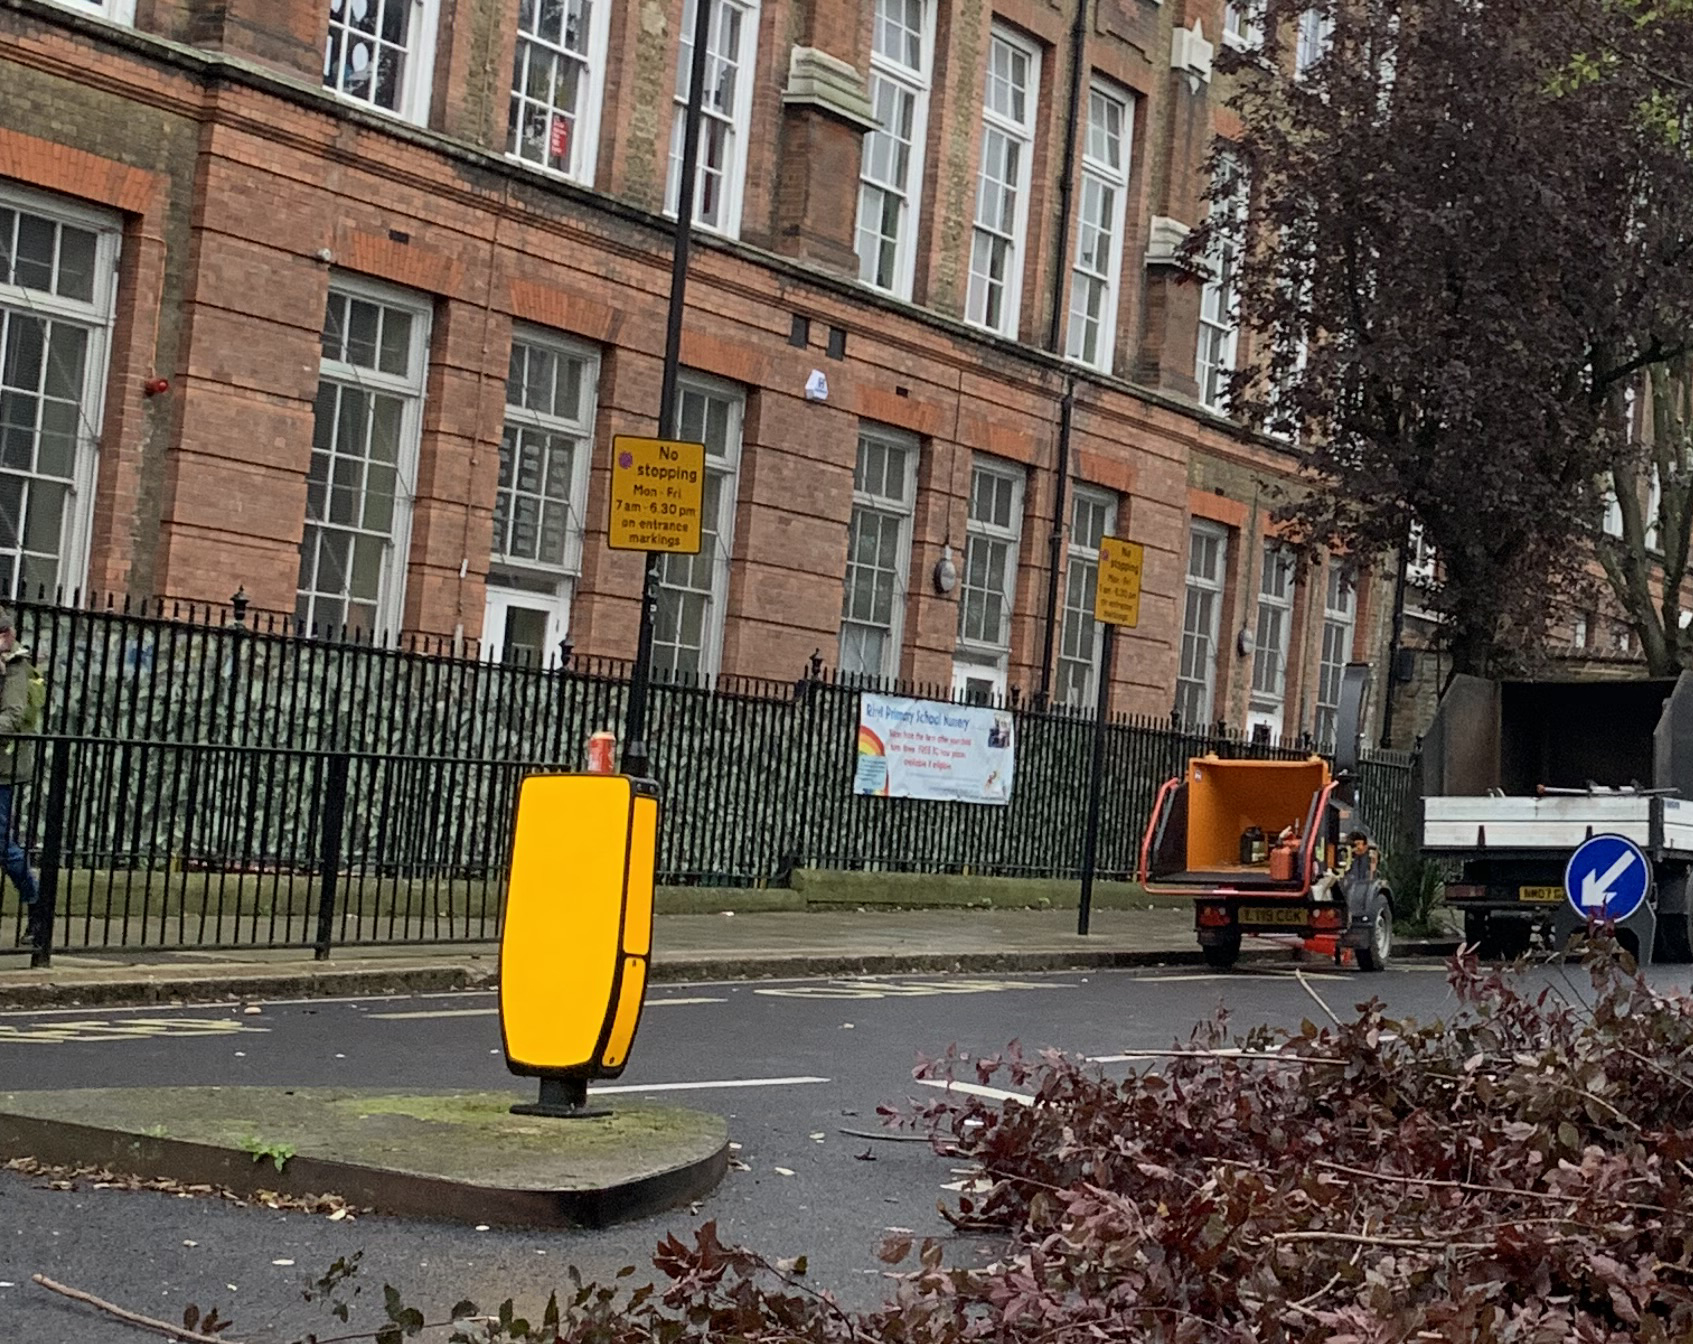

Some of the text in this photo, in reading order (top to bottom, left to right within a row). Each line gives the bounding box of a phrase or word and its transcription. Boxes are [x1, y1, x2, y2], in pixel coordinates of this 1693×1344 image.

[659, 446, 679, 461] No
[637, 463, 697, 483] stopping
[633, 484, 657, 497] Mon
[667, 487, 681, 499] Fri
[621, 519, 688, 533] on entrance
[629, 533, 680, 548] markings
